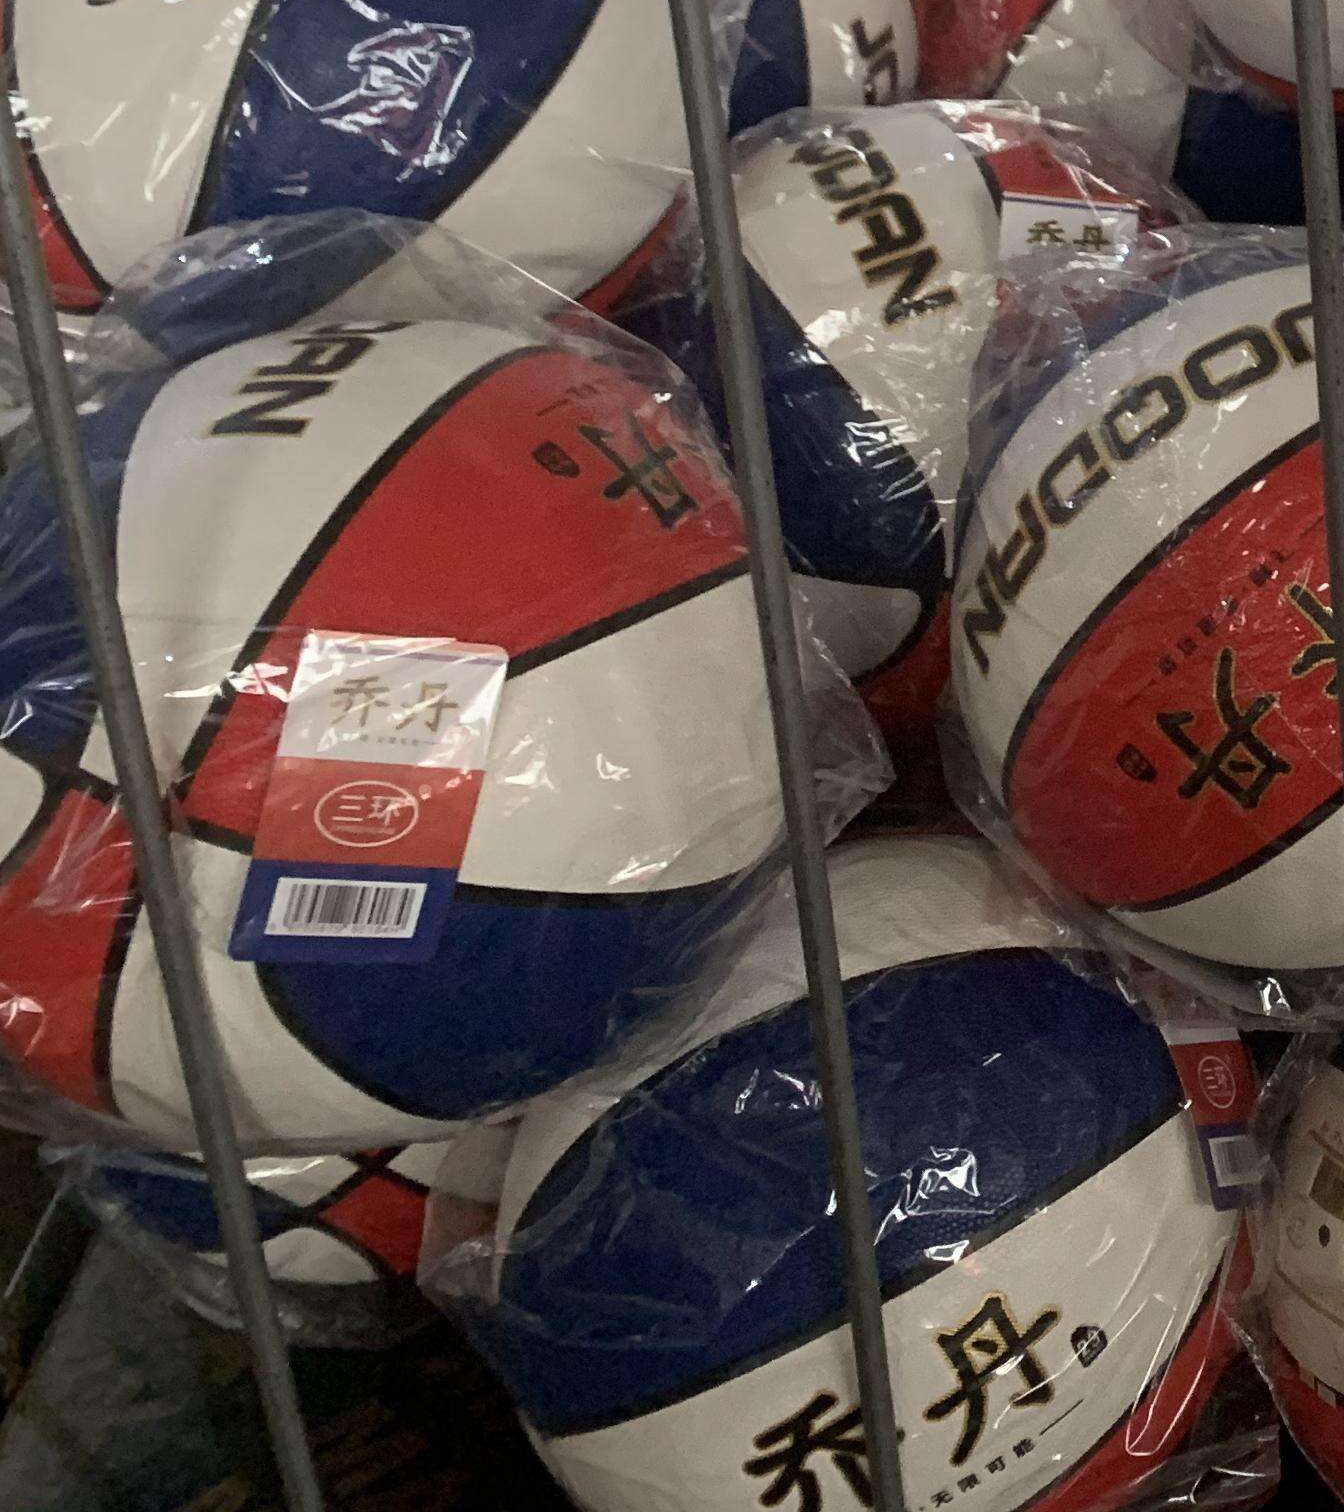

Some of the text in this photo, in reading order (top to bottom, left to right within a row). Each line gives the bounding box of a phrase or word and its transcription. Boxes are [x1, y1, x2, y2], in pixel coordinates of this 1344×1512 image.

[330, 674, 460, 736] 乔丹
[332, 790, 405, 830] 三环
[743, 1292, 1062, 1512] 乔丹
[930, 1437, 1037, 1507] 无限可能
